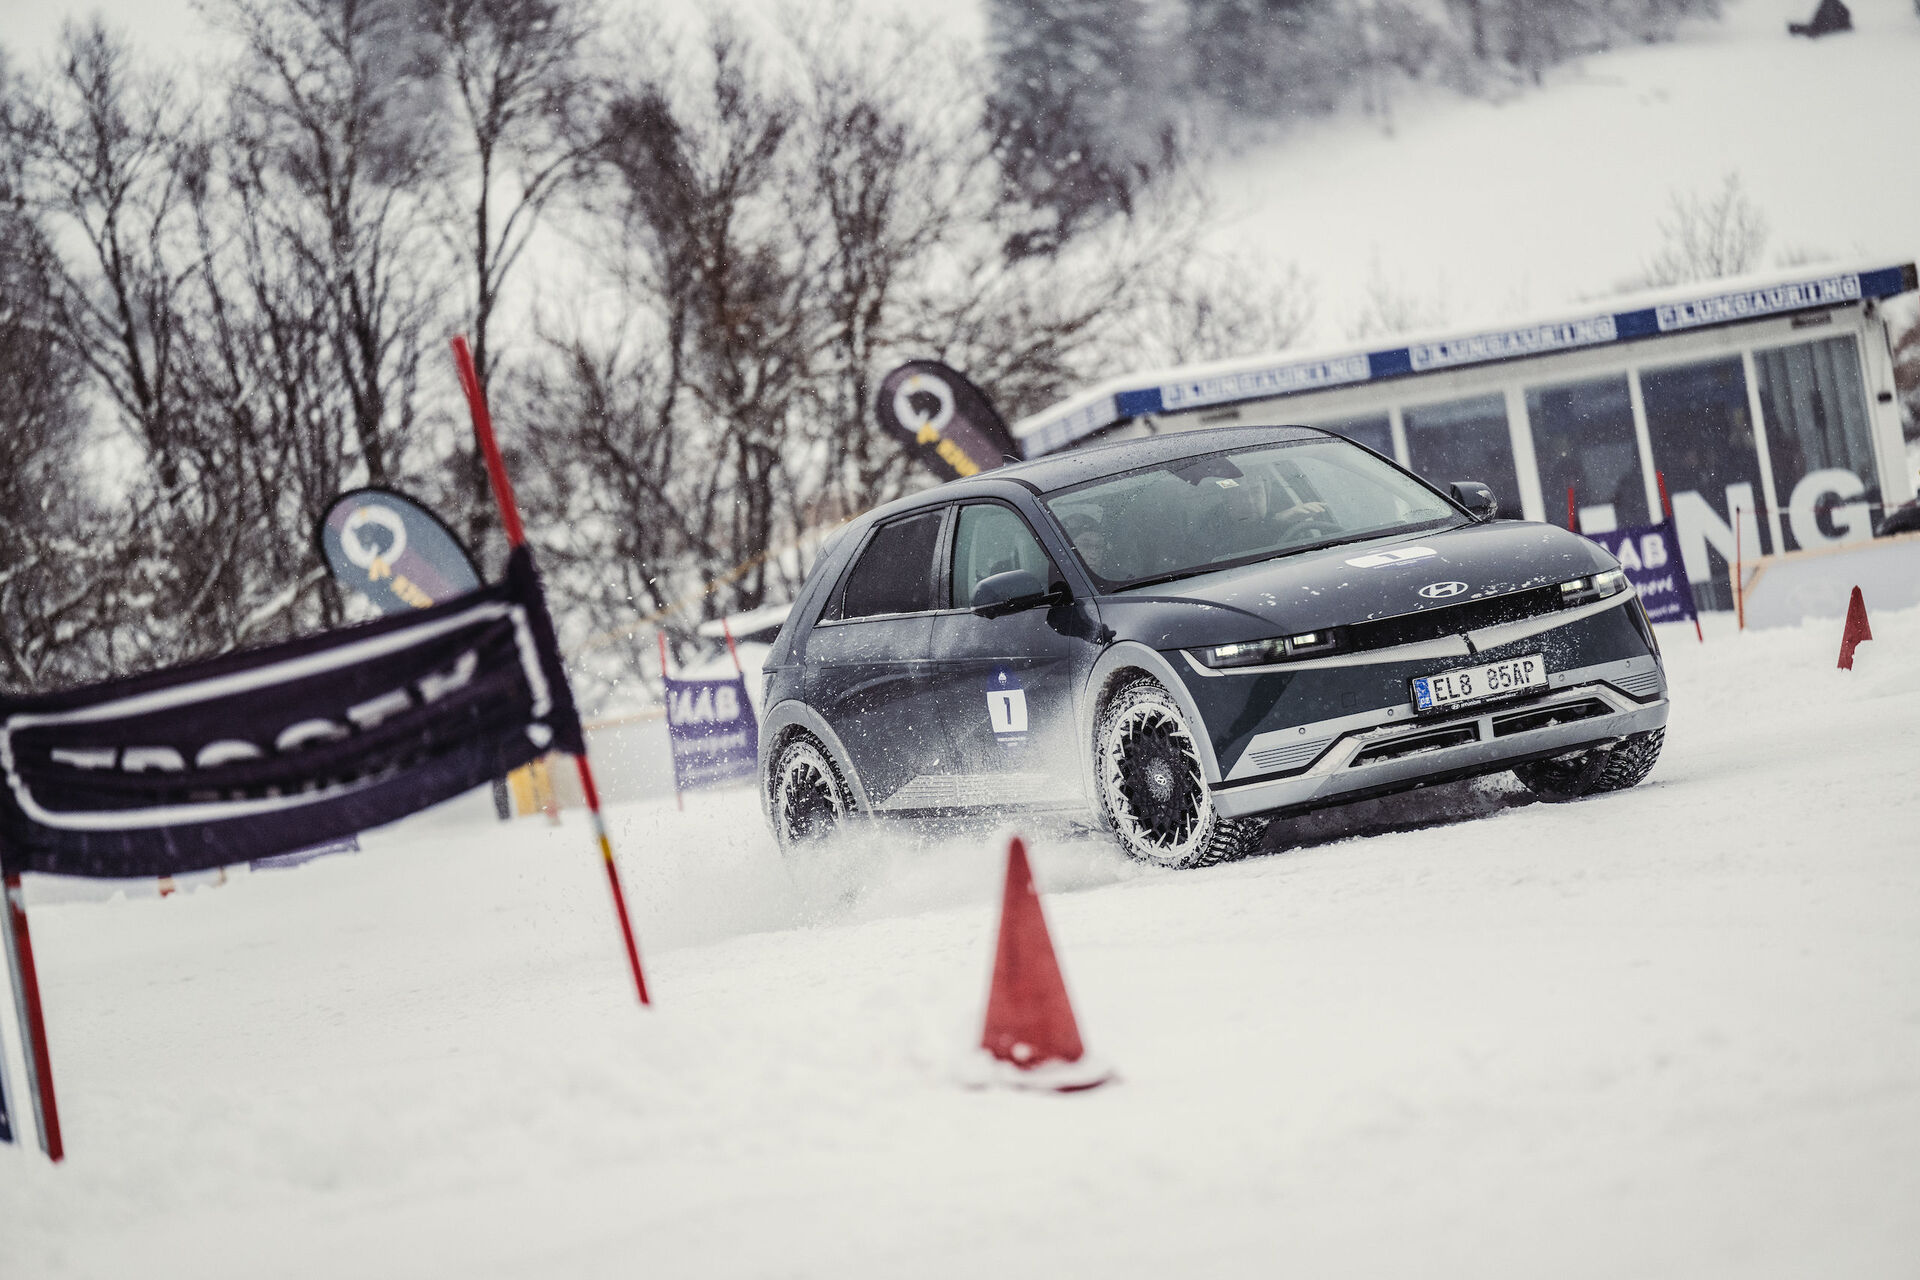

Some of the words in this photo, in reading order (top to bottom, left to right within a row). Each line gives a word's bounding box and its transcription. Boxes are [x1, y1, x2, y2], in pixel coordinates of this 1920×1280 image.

[1579, 467, 1873, 583] NG
[1600, 533, 1668, 572] AB
[1433, 673, 1473, 702] EL8
[1486, 660, 1534, 690] 85AP
[1003, 696, 1012, 725] 1
